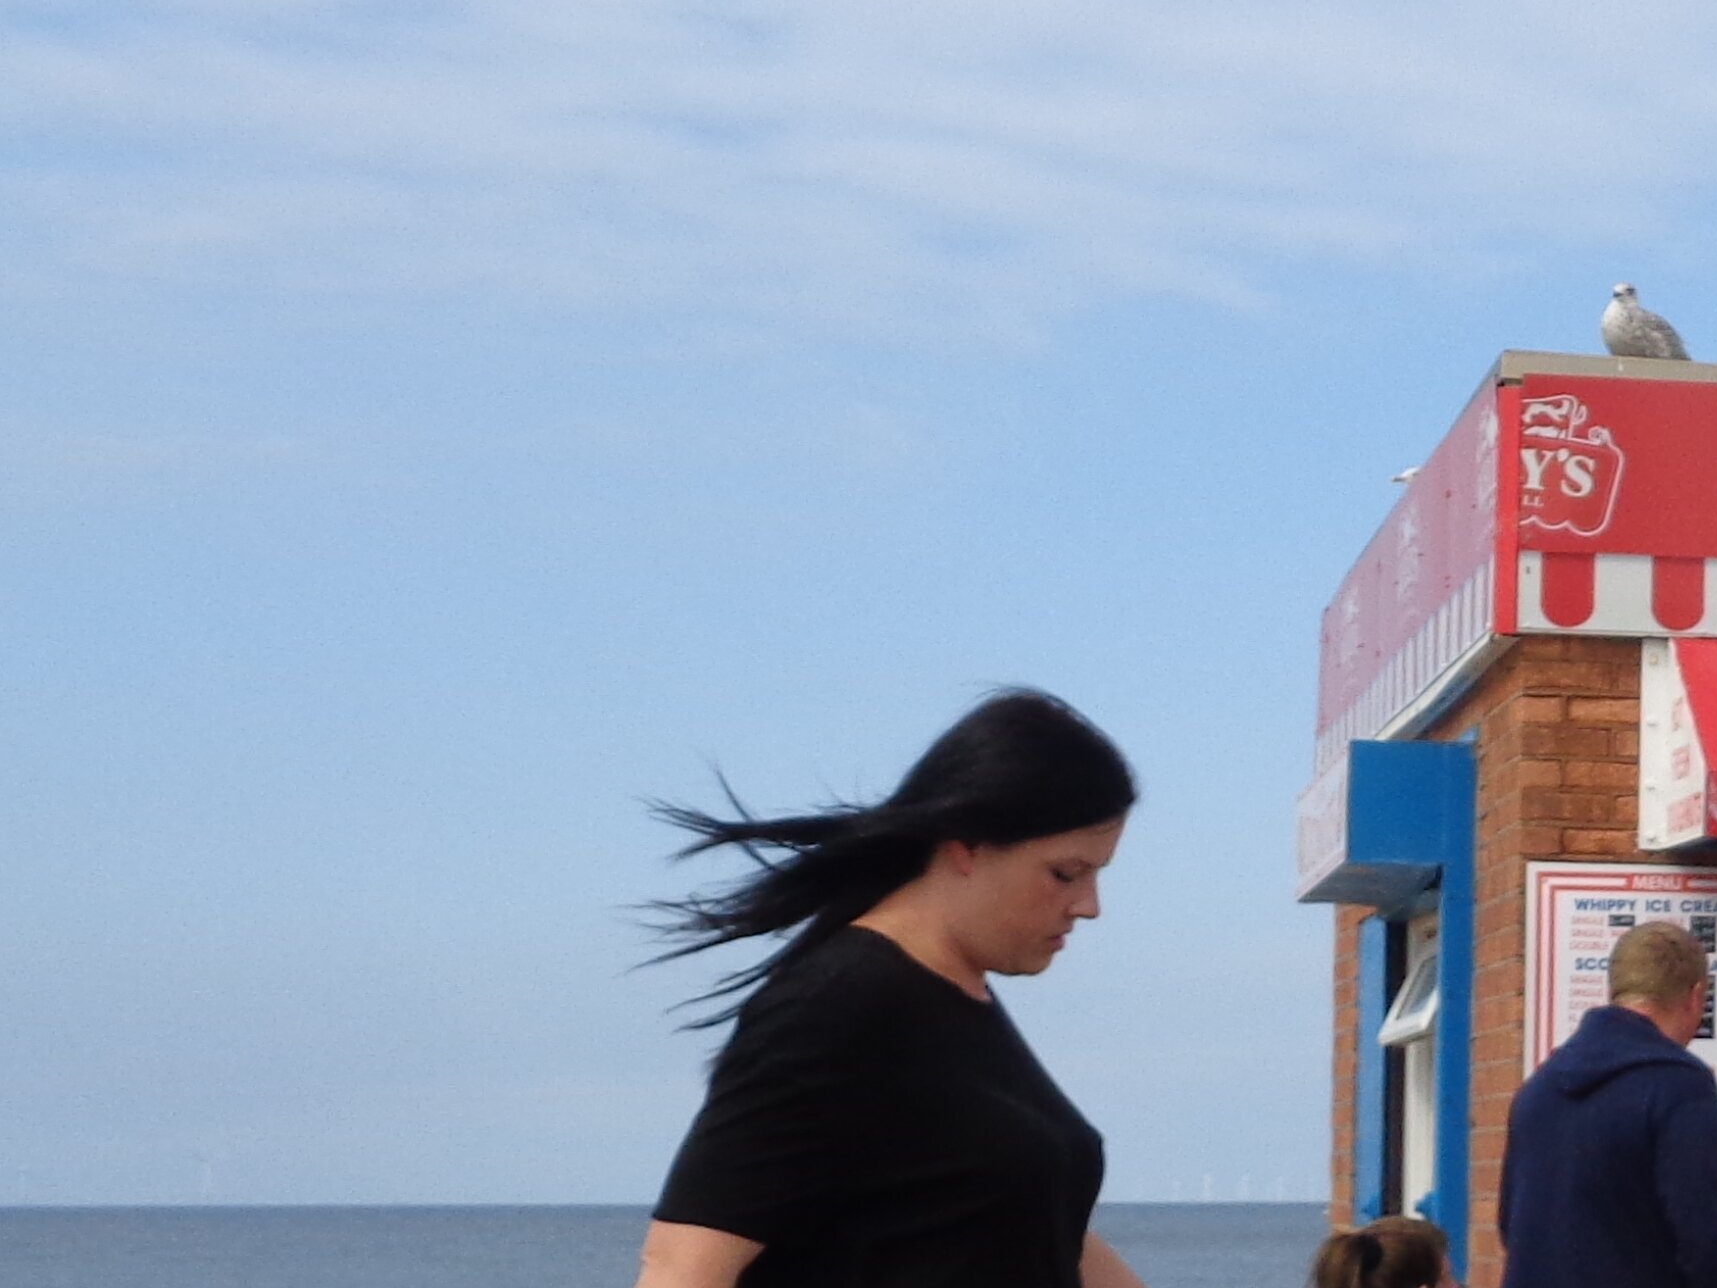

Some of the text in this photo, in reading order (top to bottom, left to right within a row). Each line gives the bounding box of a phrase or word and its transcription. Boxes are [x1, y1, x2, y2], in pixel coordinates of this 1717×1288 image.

[1632, 876, 1681, 889] MENU
[1574, 898, 1636, 911] WHIPPY
[1645, 899, 1671, 912] ICE
